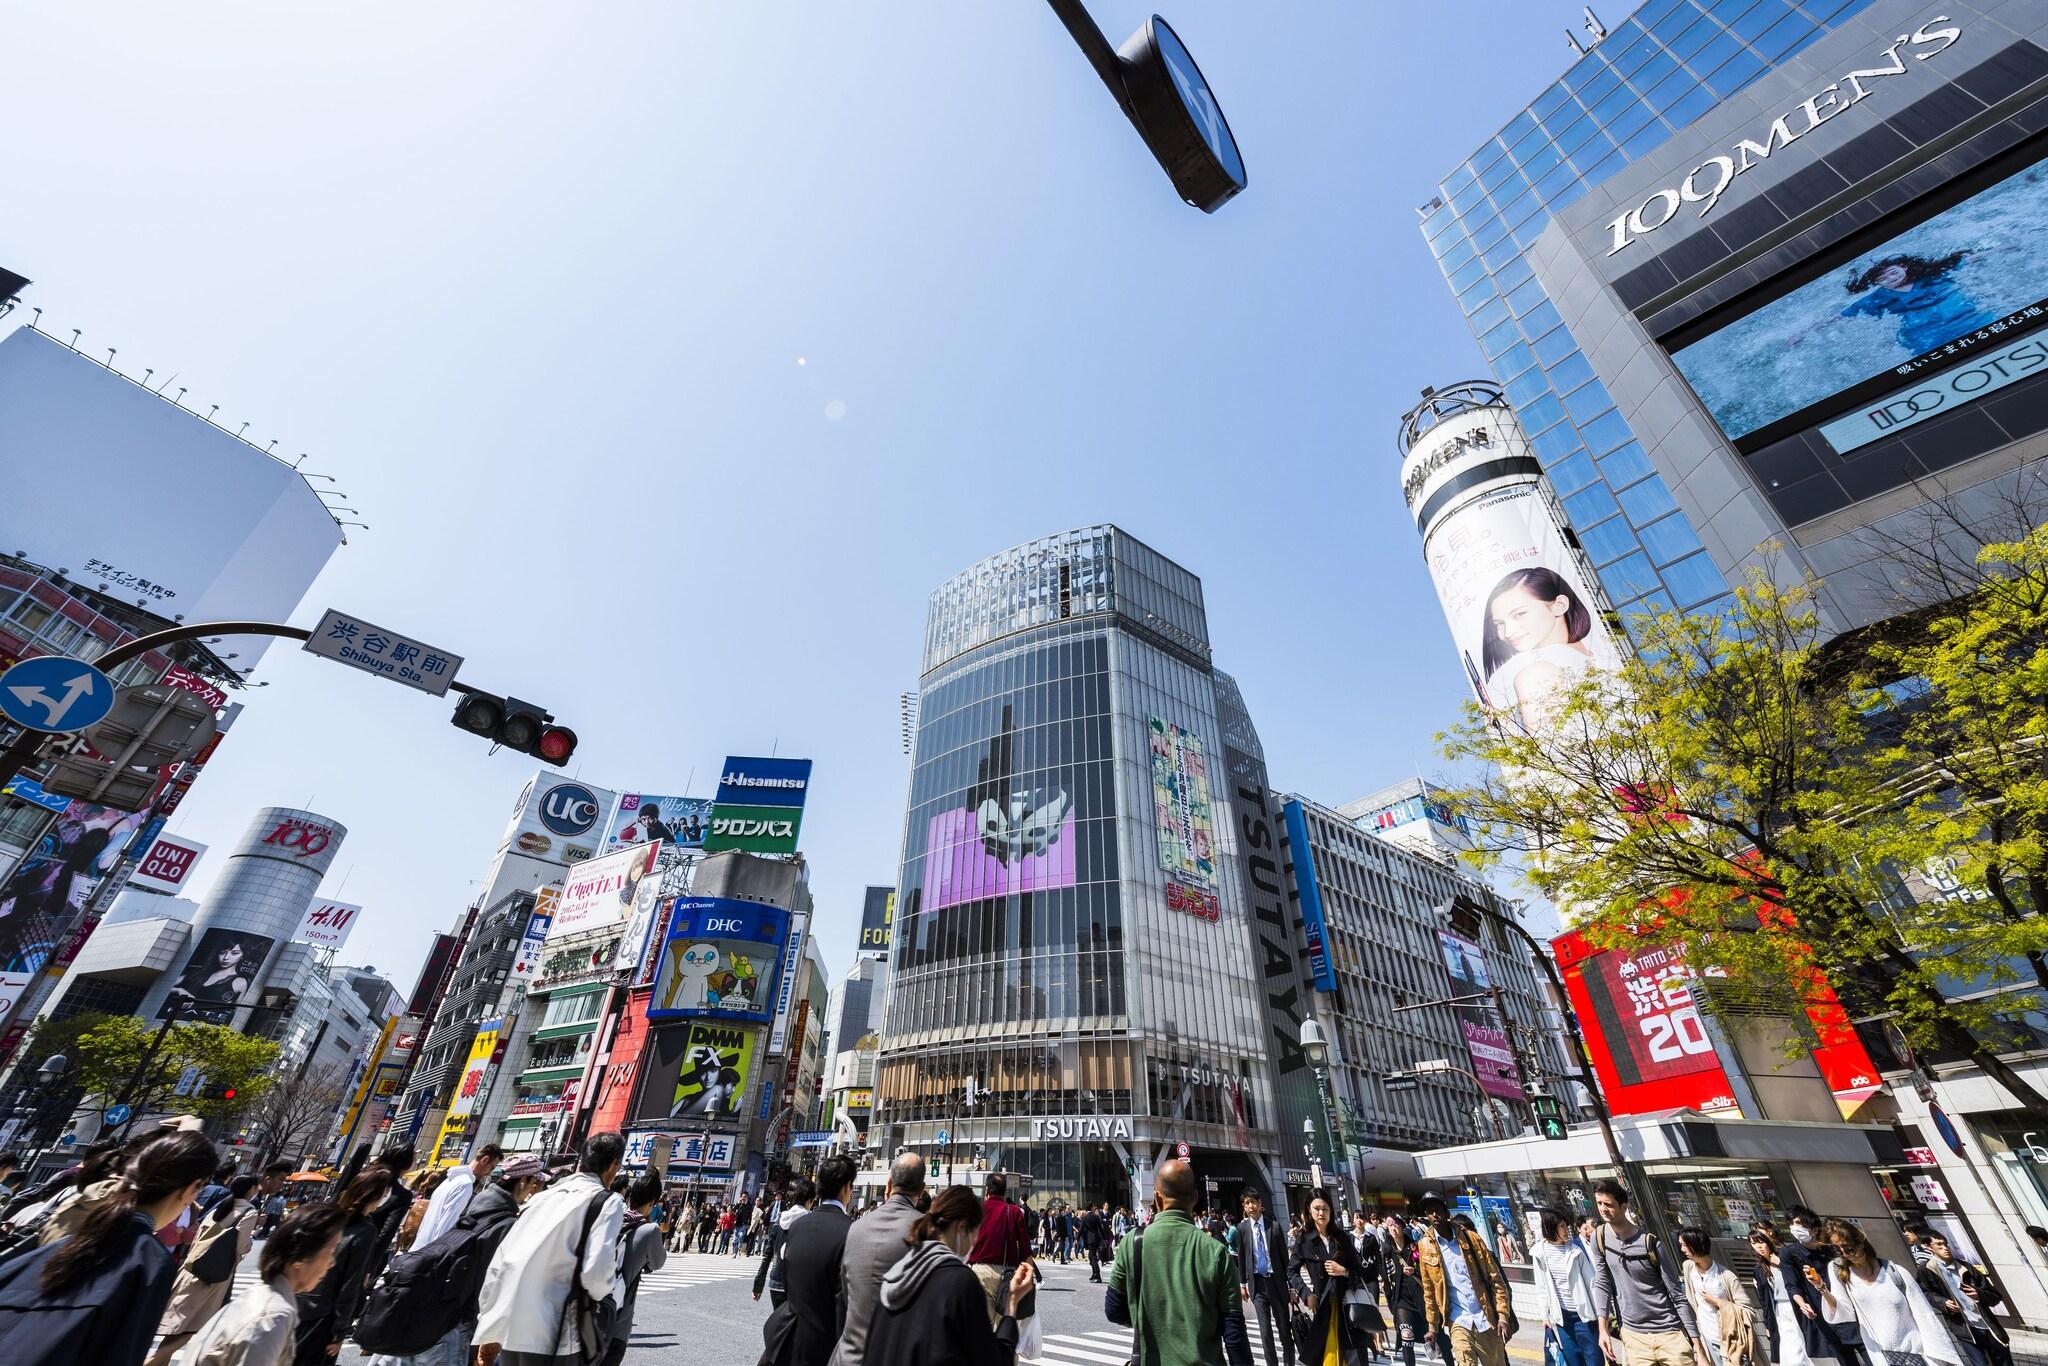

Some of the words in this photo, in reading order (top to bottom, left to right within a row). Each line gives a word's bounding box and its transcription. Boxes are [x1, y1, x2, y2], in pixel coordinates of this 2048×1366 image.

[1478, 490, 1532, 511] Panasonic
[87, 558, 177, 599] デザイン製作中
[327, 619, 449, 676] 渋谷駅前
[338, 646, 394, 673] Shibuya
[398, 666, 424, 684] Sta.
[720, 771, 806, 789] Hisamitsu
[546, 792, 597, 826] UC
[286, 818, 333, 836] SHIBUYA
[712, 817, 794, 838] サロンパス
[262, 822, 331, 858] 109
[518, 836, 552, 850] MasterCard
[155, 845, 190, 864] UNI
[566, 847, 591, 860] VISA
[146, 859, 182, 878] QLO
[1167, 882, 1220, 924] ジャンプ
[309, 904, 355, 931] H&M
[705, 918, 743, 932] DHC
[304, 929, 331, 941] 150m
[525, 951, 541, 962] まで
[1305, 922, 1328, 979] SEIBU
[1636, 950, 1667, 971] TAITO
[690, 1027, 745, 1050] DMM
[1639, 1007, 1713, 1064] 20
[530, 1055, 572, 1068] Euphoria
[685, 1046, 724, 1067] FX
[1181, 1064, 1251, 1093] TSUTAYA
[1851, 1075, 1870, 1088] pdc
[1034, 1118, 1130, 1138] TSUTAYA
